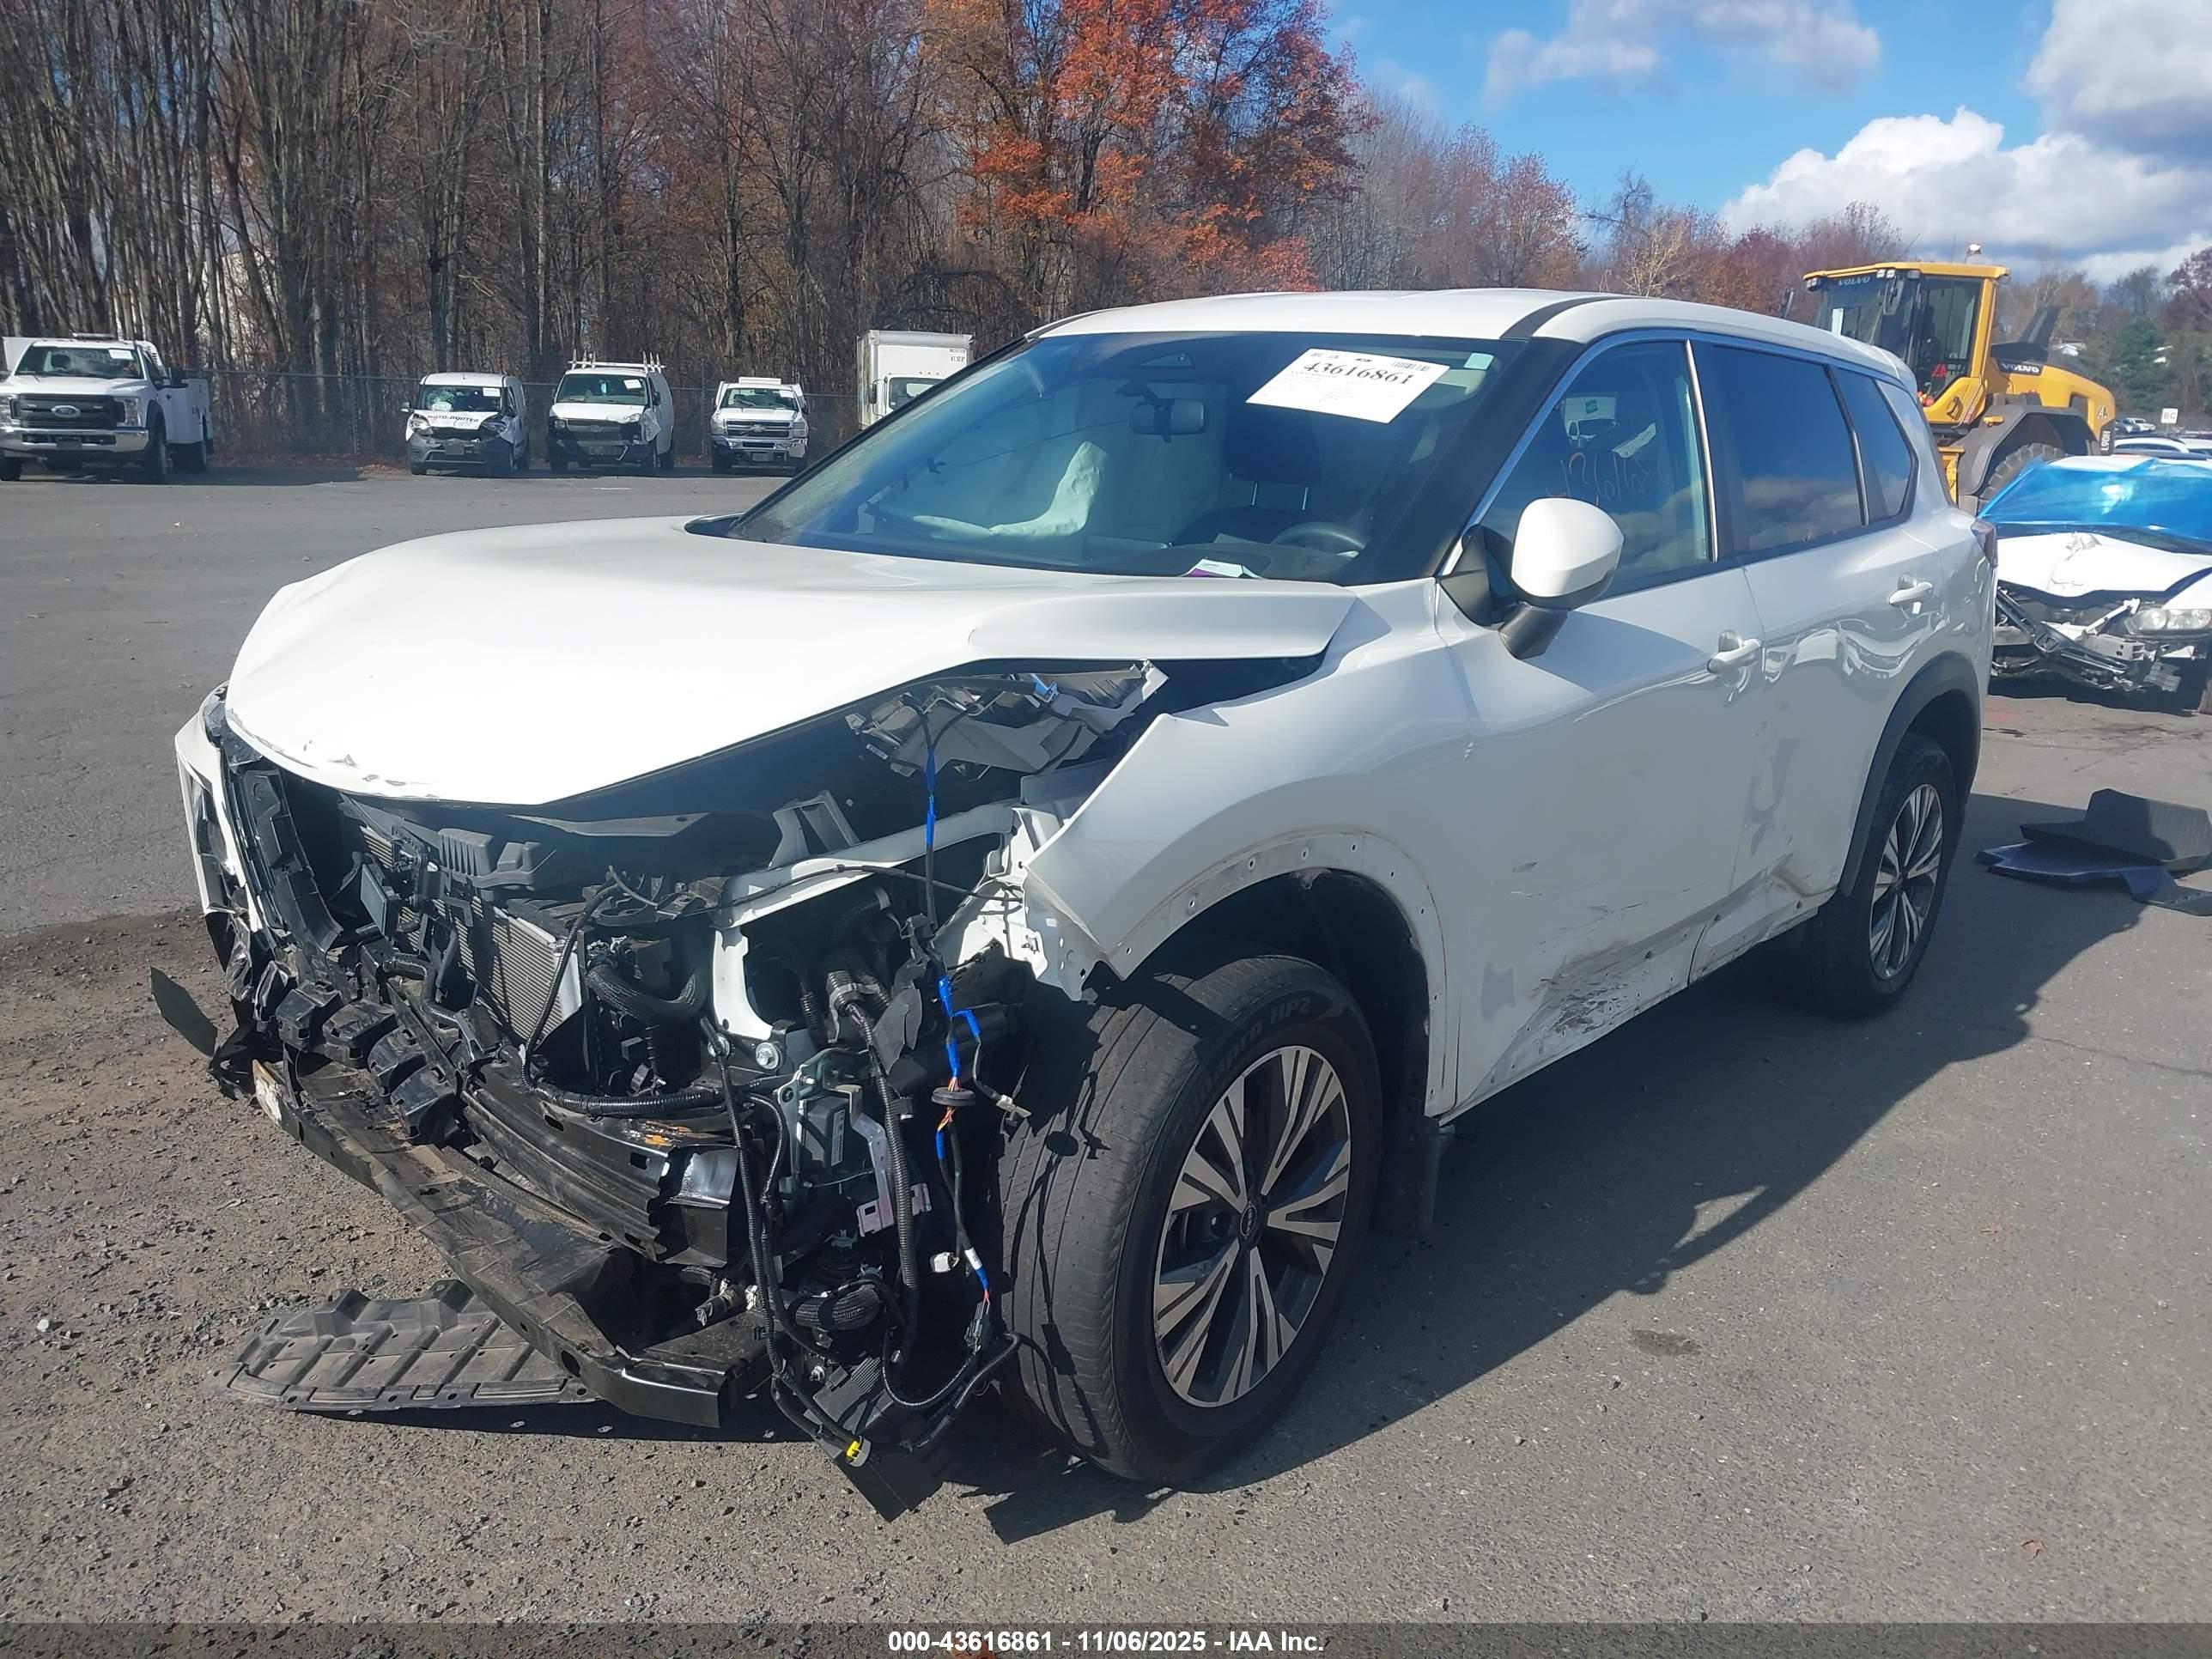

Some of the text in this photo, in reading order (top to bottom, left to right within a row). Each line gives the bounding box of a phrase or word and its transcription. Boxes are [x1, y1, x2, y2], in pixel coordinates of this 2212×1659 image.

[1838, 276, 1870, 286] VOLVO
[1304, 362, 1414, 385] 43616861
[2002, 362, 2039, 373] VOLVO
[1270, 996, 1311, 1025] HP2
